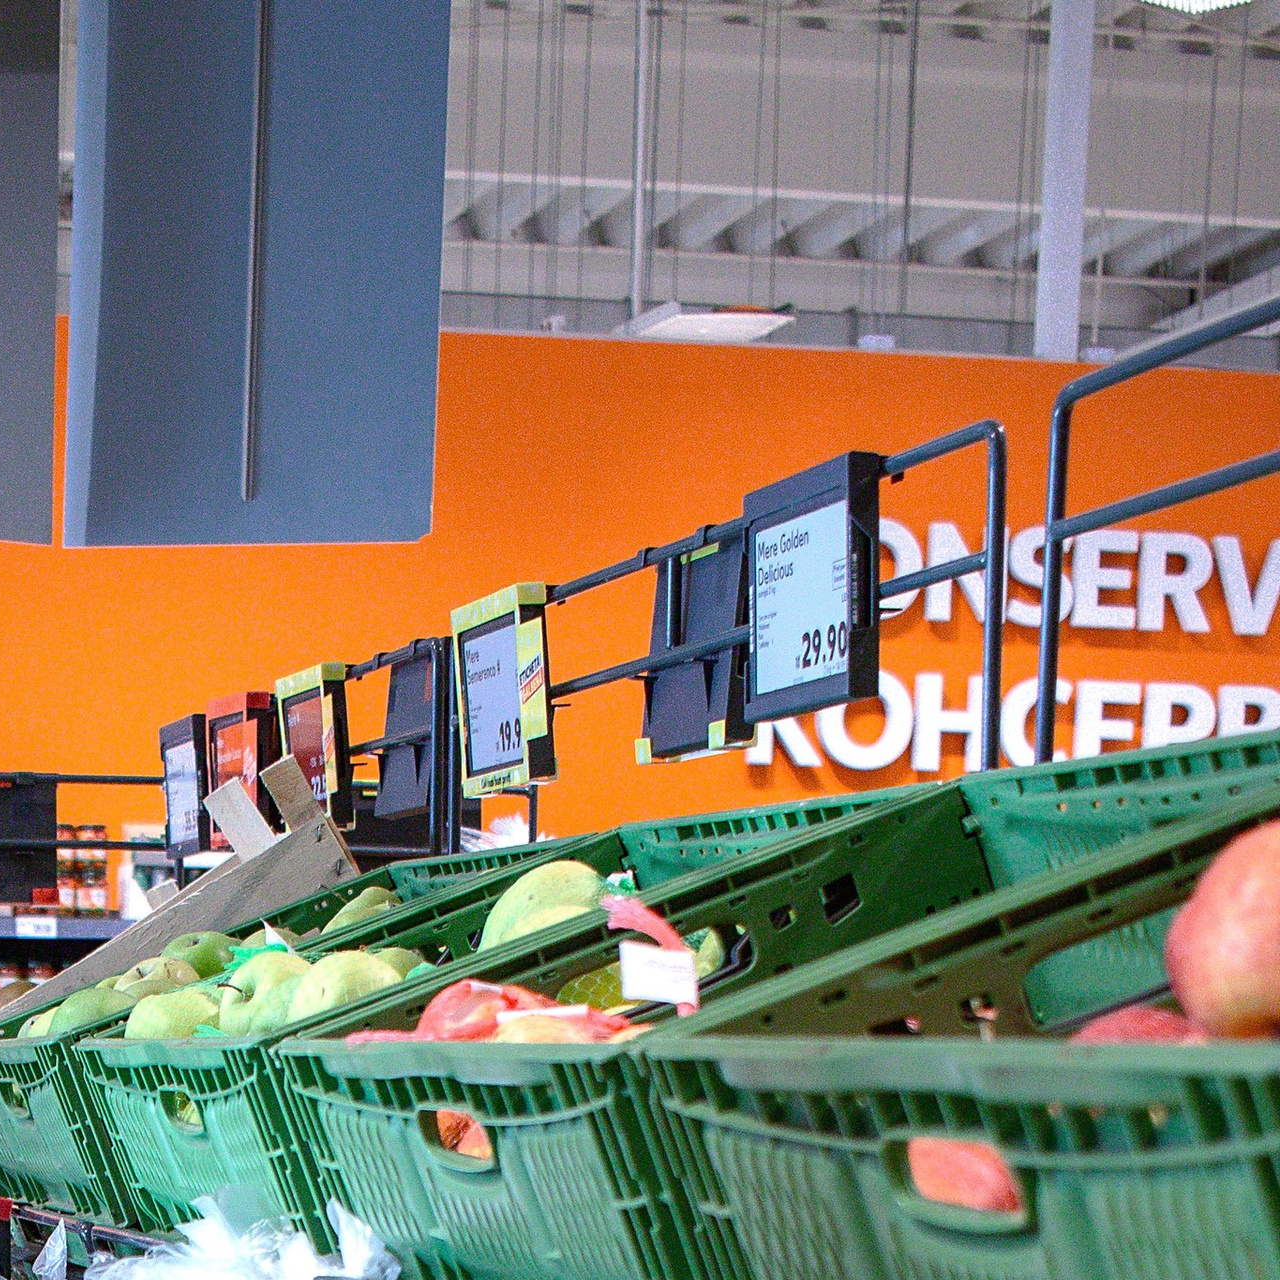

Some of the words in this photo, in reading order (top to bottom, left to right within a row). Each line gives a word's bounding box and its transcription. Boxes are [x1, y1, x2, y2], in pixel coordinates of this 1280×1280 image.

[757, 540, 778, 563] Mere
[779, 529, 810, 554] Golden
[757, 560, 794, 587] Delicious
[801, 620, 847, 670] 29.90
